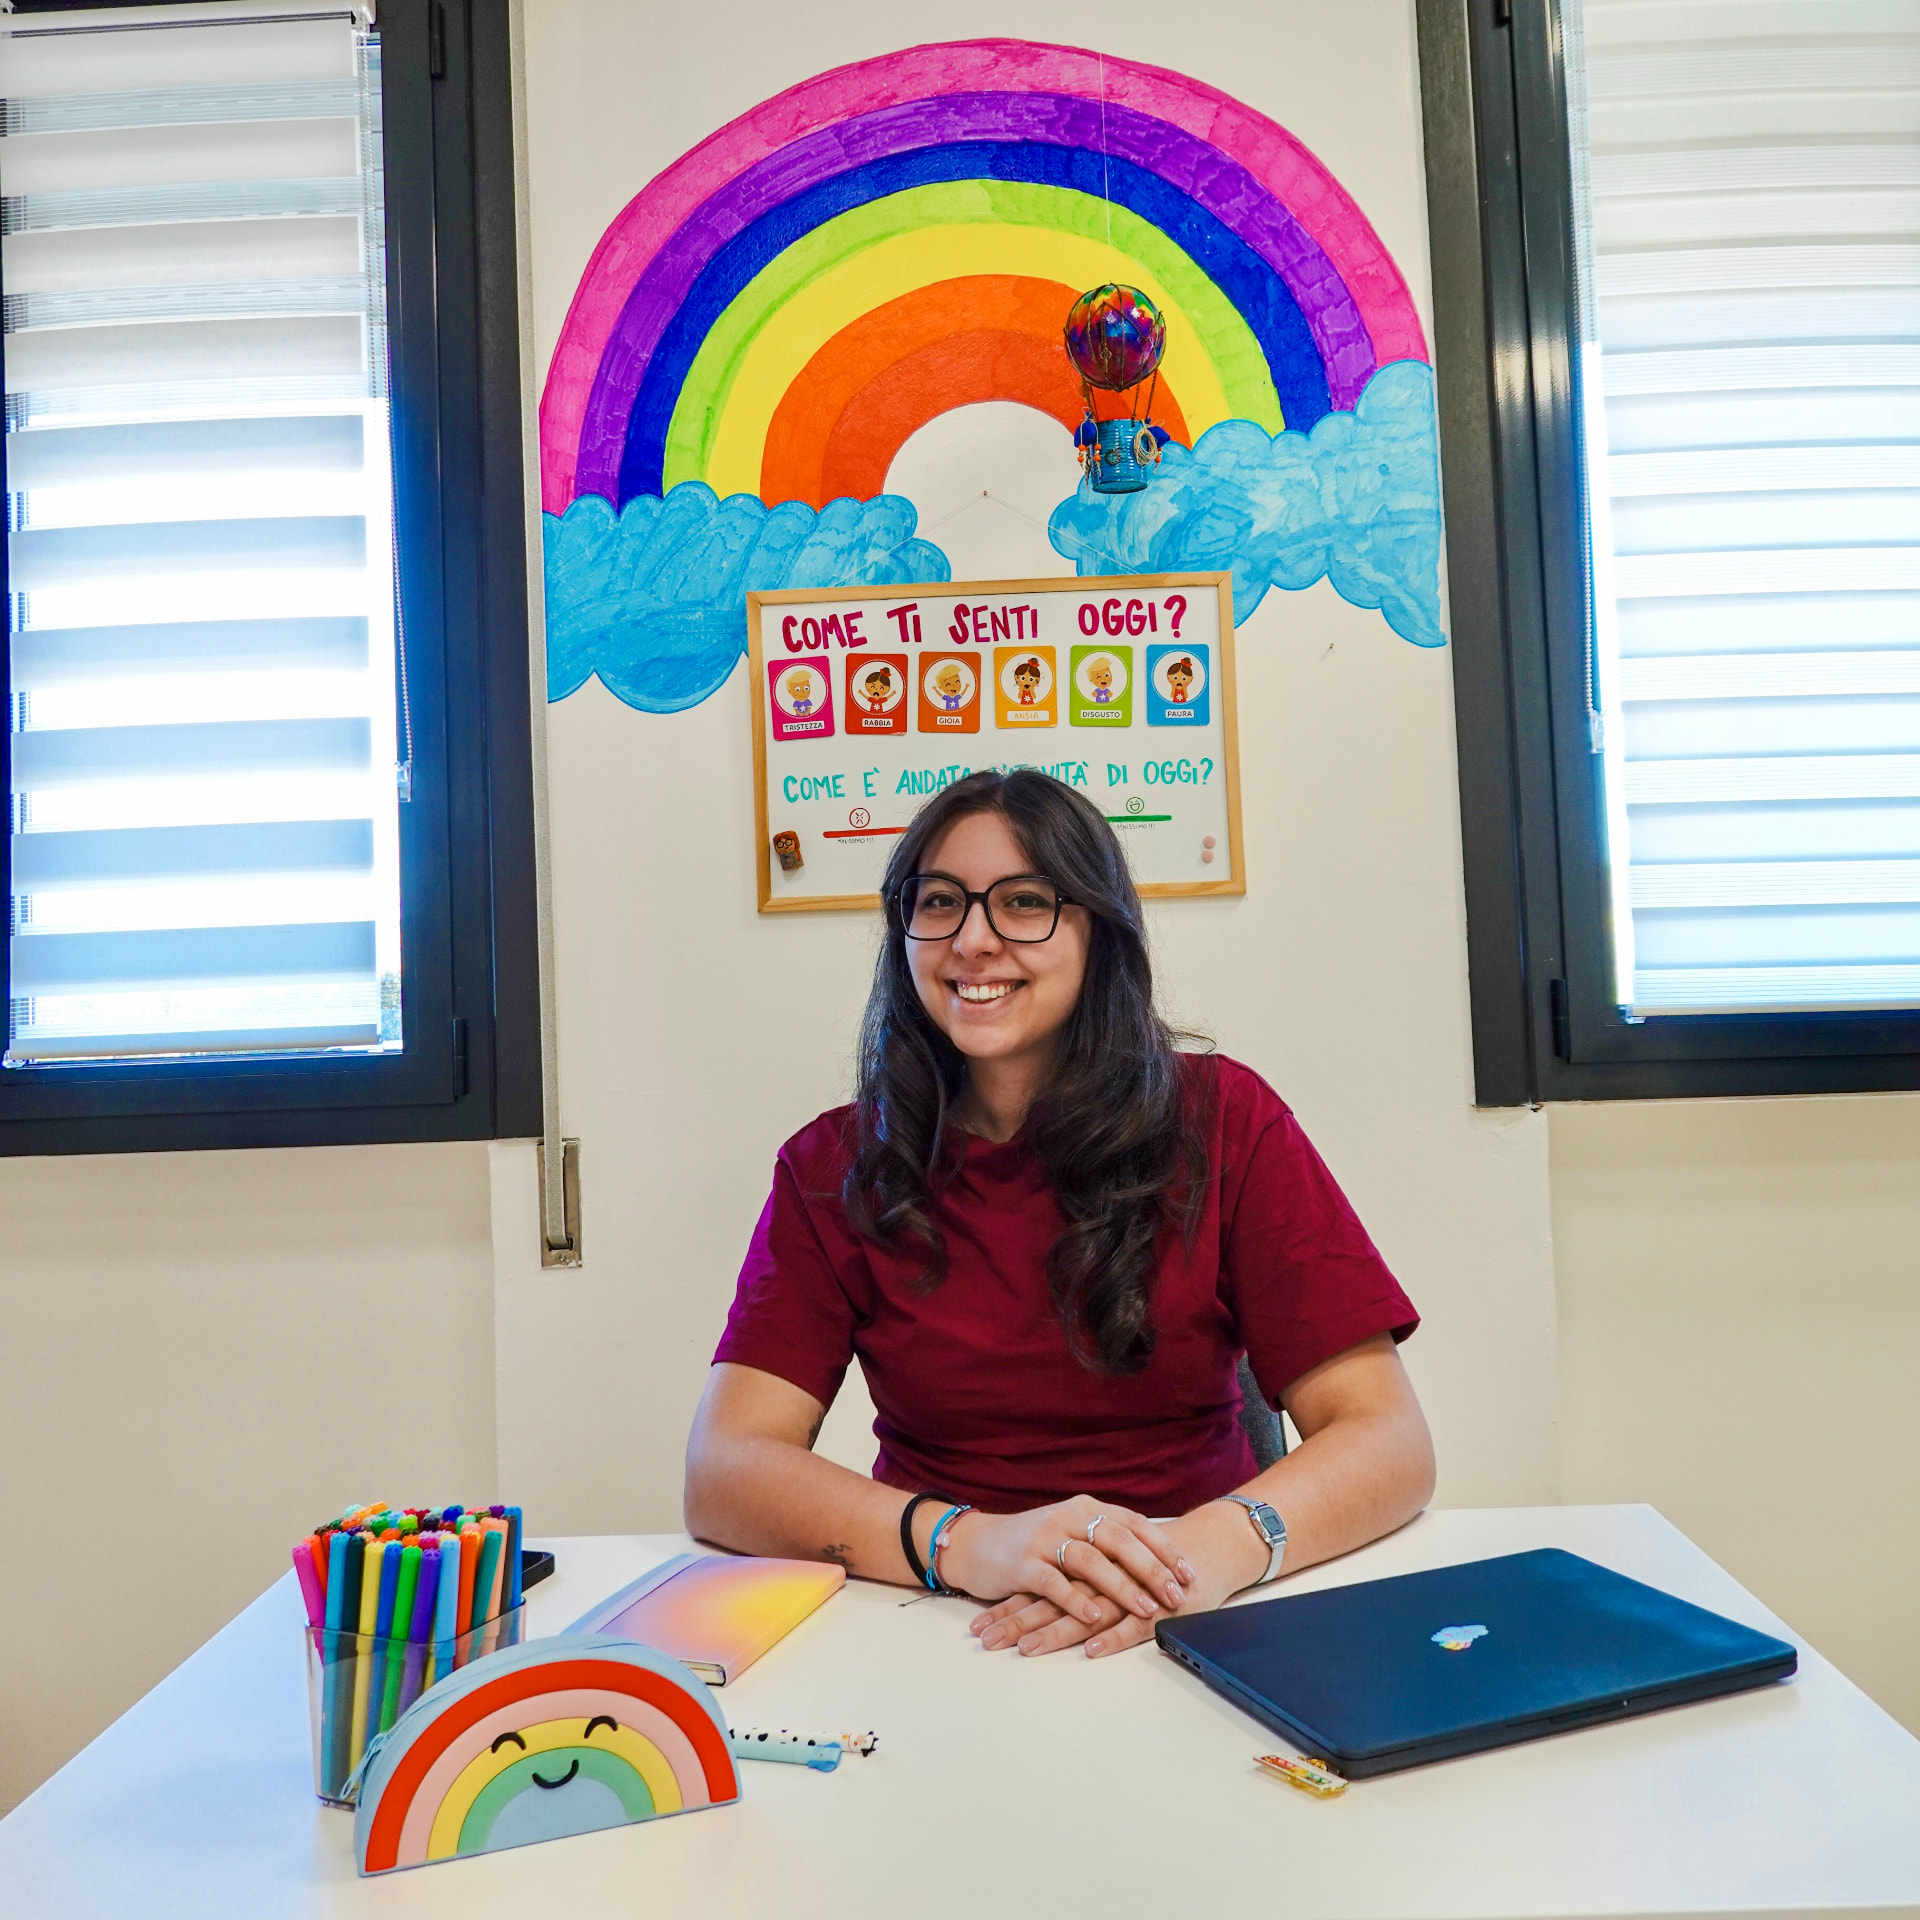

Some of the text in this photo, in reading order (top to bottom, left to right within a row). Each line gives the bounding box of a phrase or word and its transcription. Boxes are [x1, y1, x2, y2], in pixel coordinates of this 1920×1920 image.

[782, 594, 1187, 653] COME TI SENTI OGGI?
[1014, 711, 1039, 720] ANSIA
[1082, 711, 1121, 719] DISGUSTO
[1167, 710, 1193, 718] PAURA
[864, 719, 892, 727] RABBIA
[938, 717, 960, 725] GIOIA
[784, 722, 823, 731] TRISTEZZA
[783, 774, 846, 804] COME
[1106, 763, 1129, 787] DI
[1143, 757, 1214, 786] OGGI?
